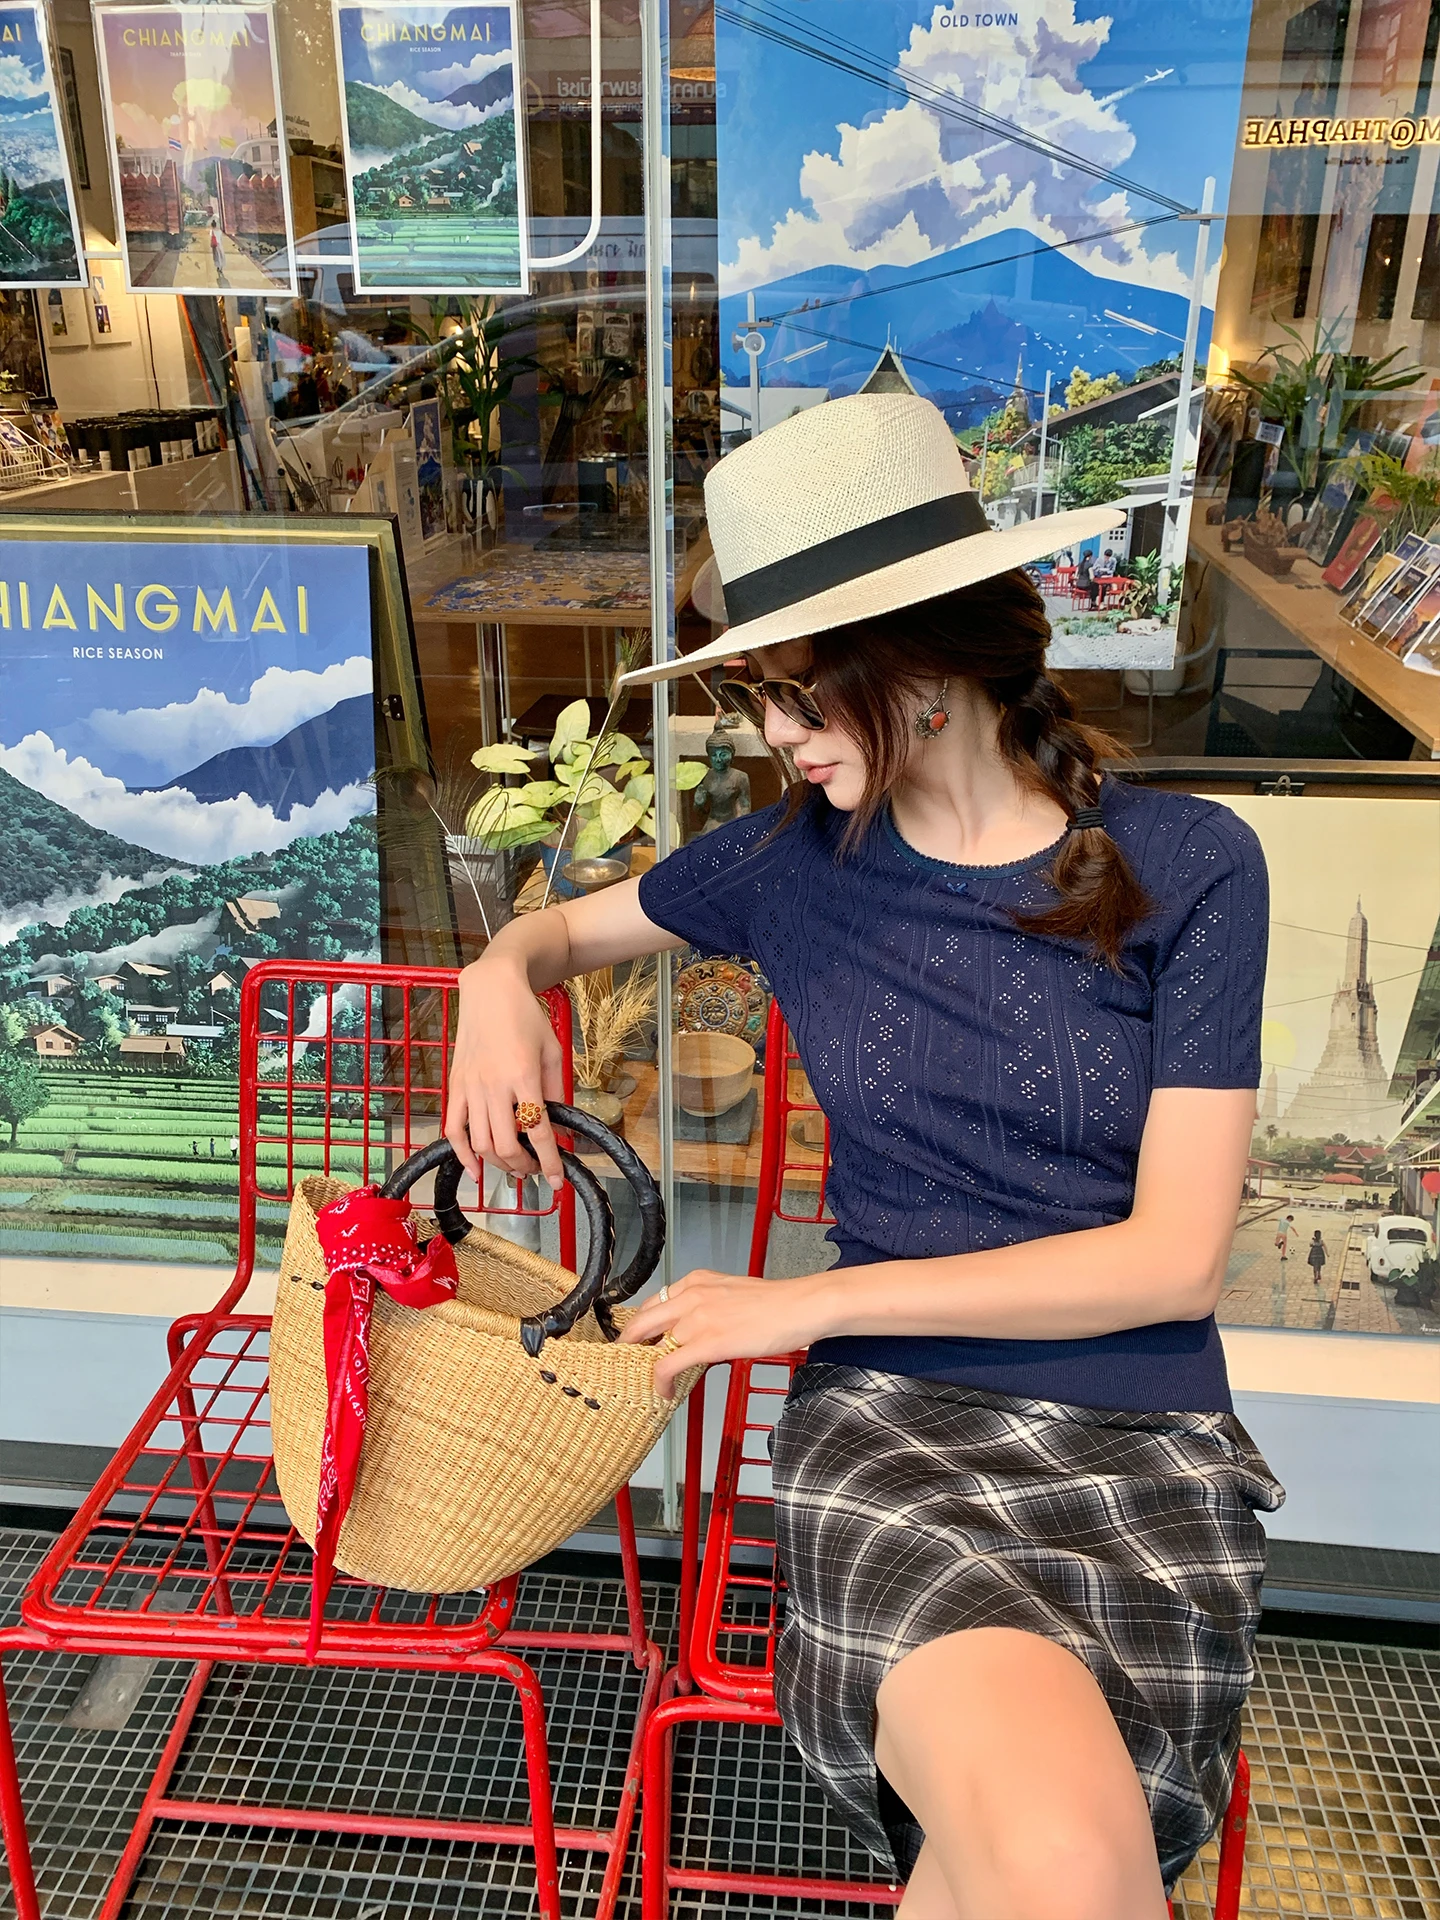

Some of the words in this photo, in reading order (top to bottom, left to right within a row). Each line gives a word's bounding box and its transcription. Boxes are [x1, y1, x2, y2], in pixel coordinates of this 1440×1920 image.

[940, 15, 969, 28] OLD
[975, 13, 1018, 27] TOWN
[123, 28, 249, 47] CHIANGMAI
[360, 22, 491, 43] CHIANGMAI
[73, 646, 104, 660] RICE
[108, 647, 163, 661] SEASON
